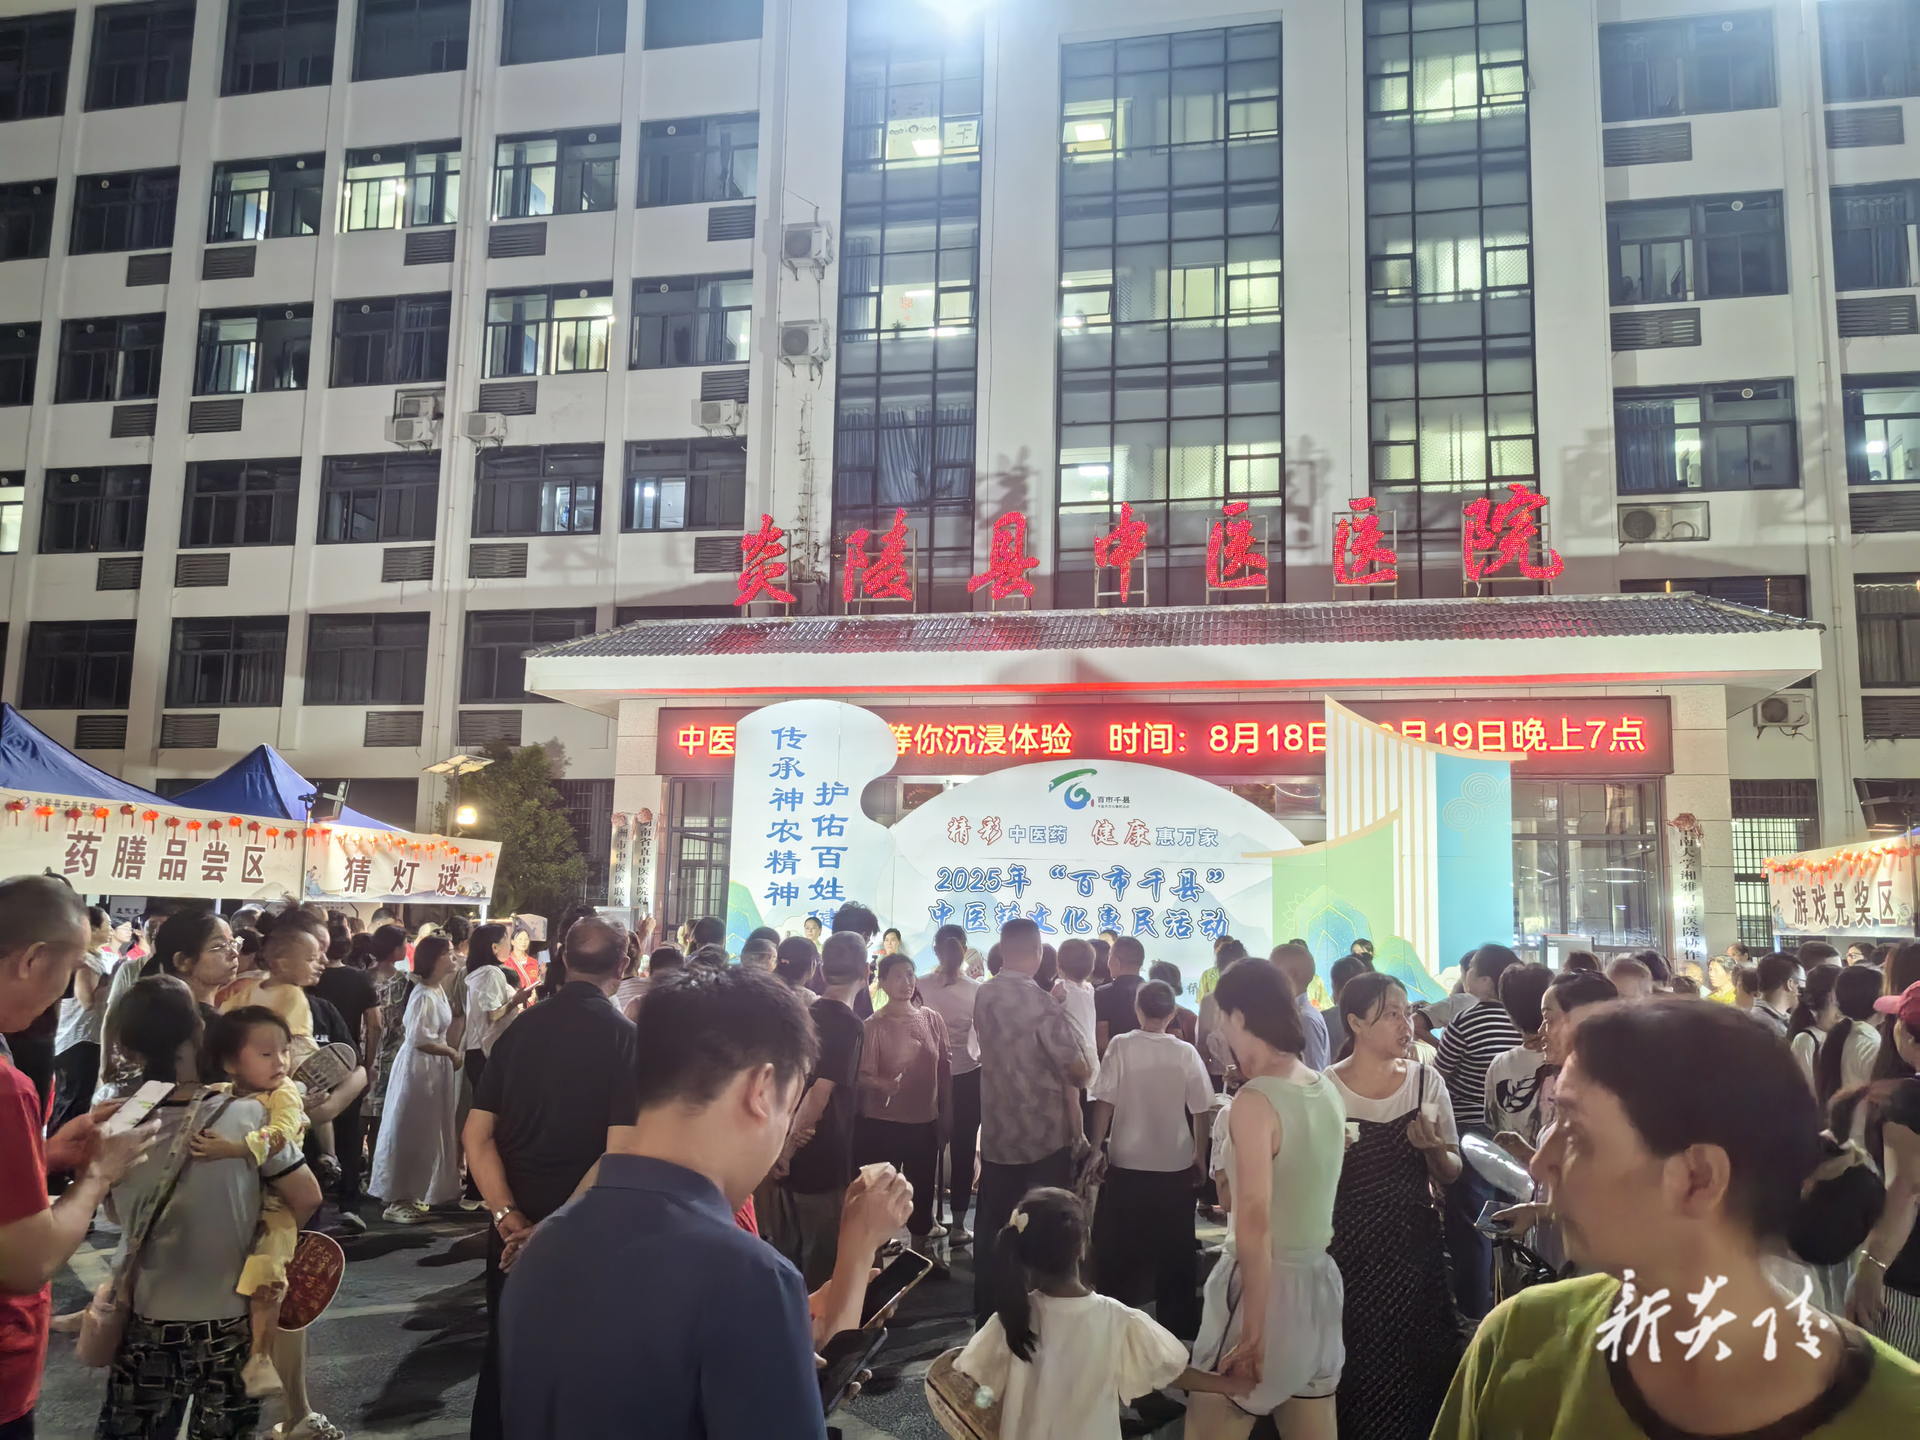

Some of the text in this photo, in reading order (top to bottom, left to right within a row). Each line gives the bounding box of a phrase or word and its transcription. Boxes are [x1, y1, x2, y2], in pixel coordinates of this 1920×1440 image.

[734, 483, 1566, 607] 炎陵县中医医院
[678, 725, 736, 756] 中医
[888, 723, 1072, 755] 等你沉浸体验
[1379, 717, 1646, 753] 月19日晚上7点
[764, 726, 807, 907] 传承神农精神
[1097, 796, 1131, 804] 百市千县
[64, 830, 266, 884] 药膳品尝区
[343, 856, 461, 896] 猜灯谜
[614, 820, 628, 907] 洲市中医医联体
[1679, 829, 1700, 960] 南大学湘雅腔医院协作
[1792, 880, 1896, 927] 游戏兑奖区
[928, 899, 1230, 941] 中医药文化惠民活动
